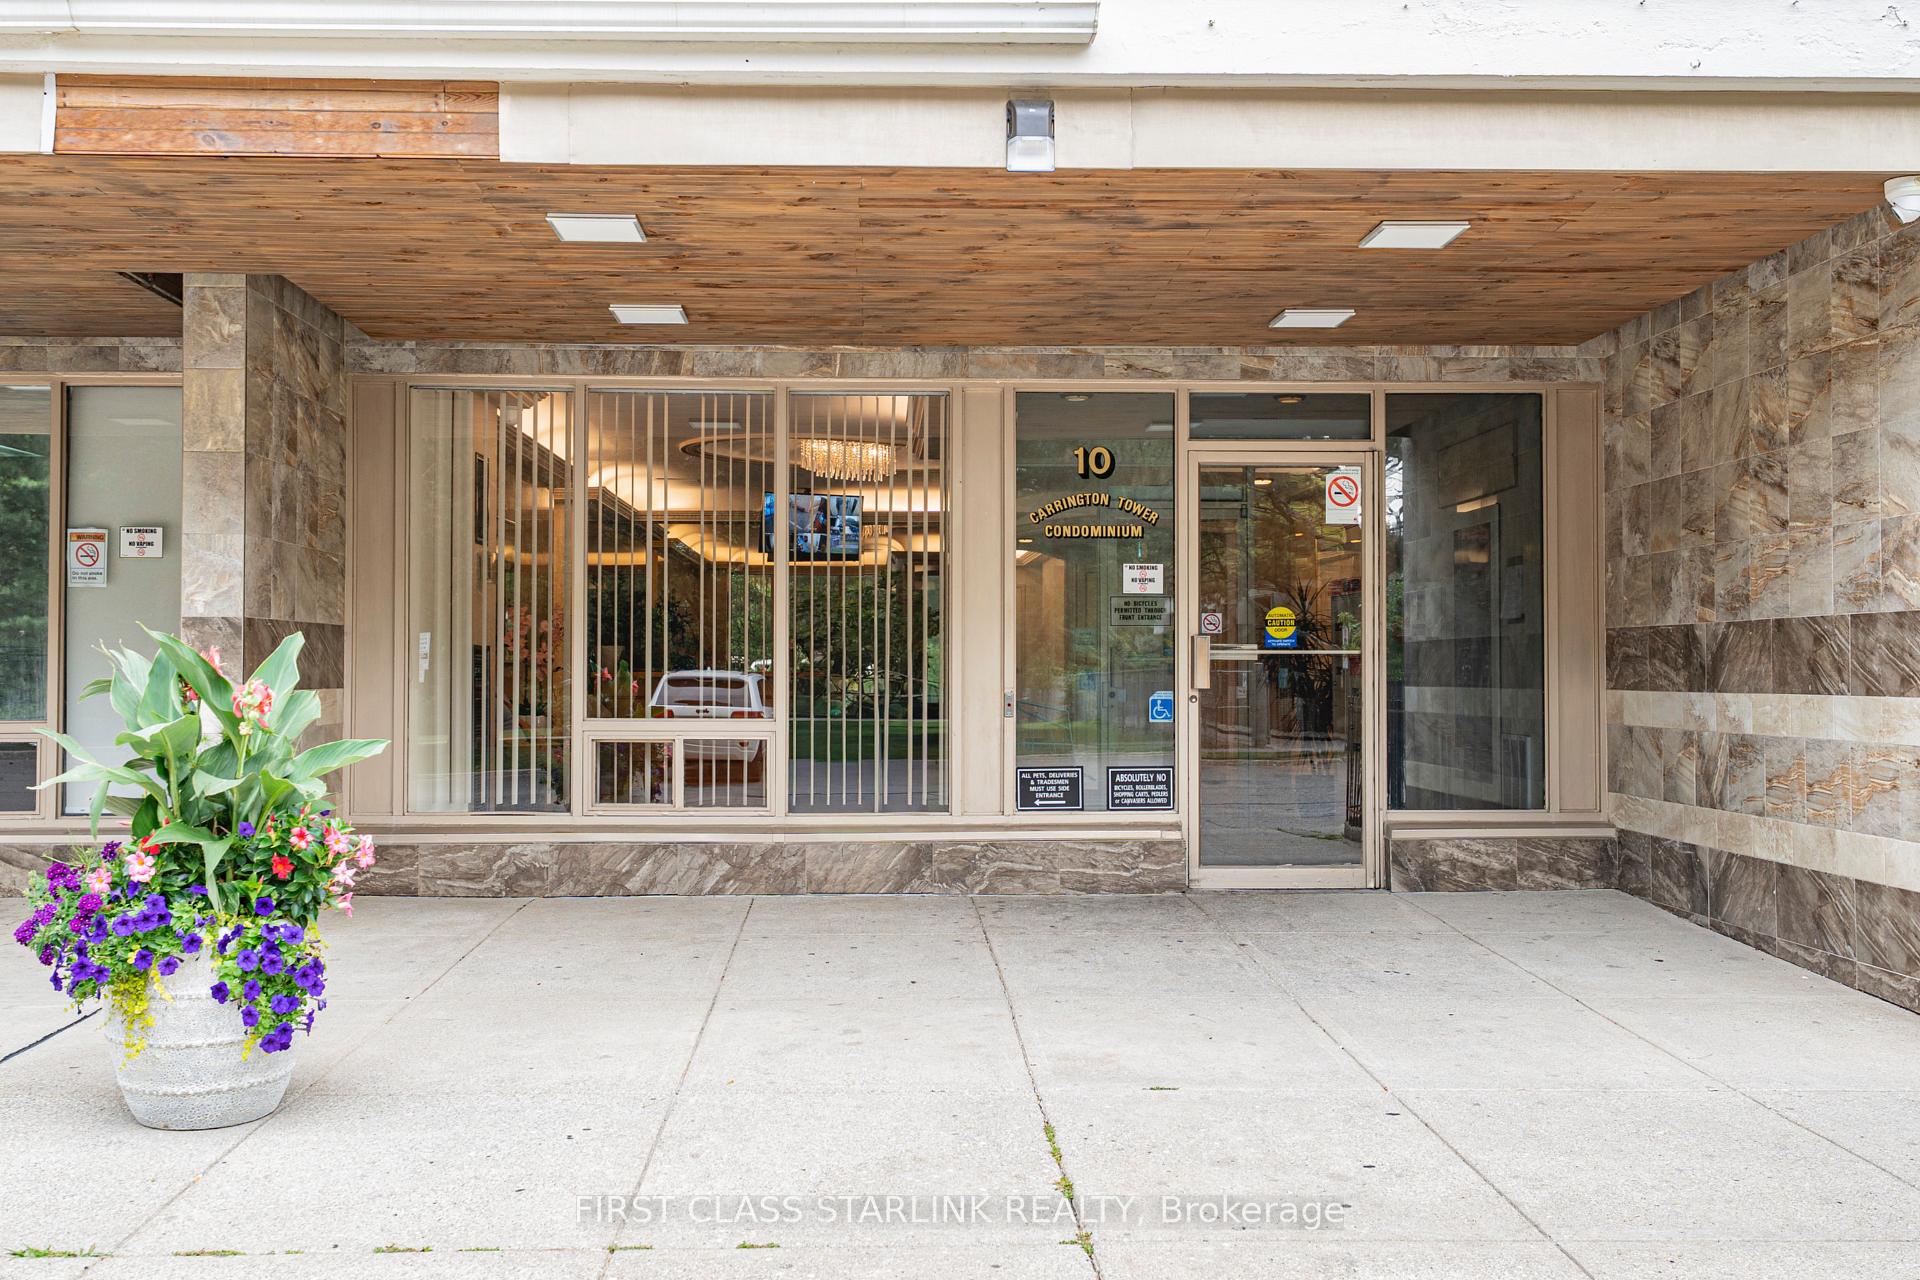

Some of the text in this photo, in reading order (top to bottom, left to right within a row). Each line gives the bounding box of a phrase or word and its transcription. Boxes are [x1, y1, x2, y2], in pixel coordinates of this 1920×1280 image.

[1073, 446, 1114, 478] 10
[1029, 493, 1160, 525] CARRINGTON TOWER
[1044, 525, 1143, 538] CONDOMINIUM
[1115, 773, 1167, 782] ABSOLUTELY NO
